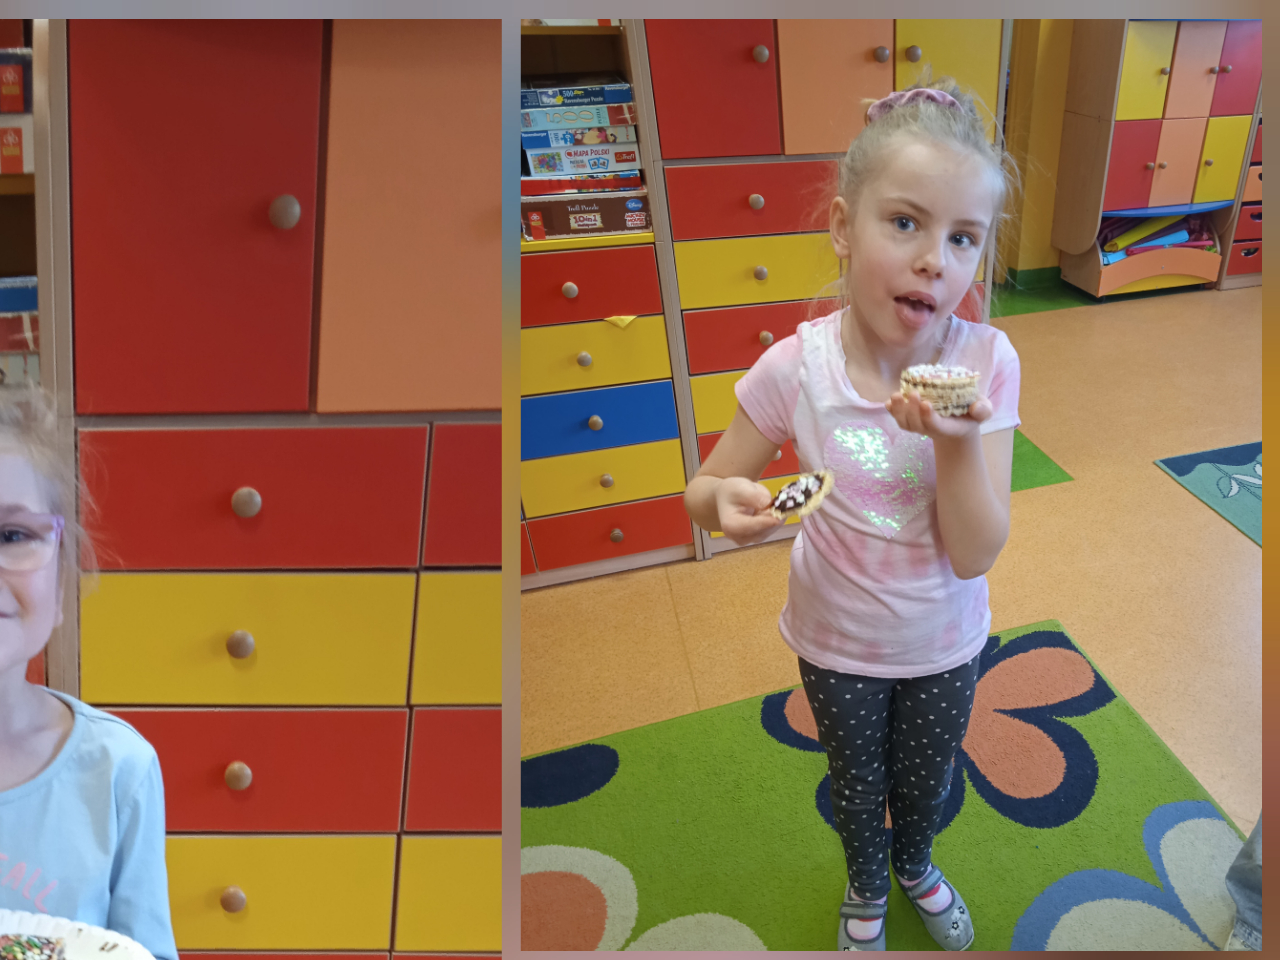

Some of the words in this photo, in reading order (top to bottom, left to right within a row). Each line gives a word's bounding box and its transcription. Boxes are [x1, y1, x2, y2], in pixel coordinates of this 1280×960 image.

[546, 110, 594, 124] 500
[573, 149, 589, 157] MAPA
[590, 148, 610, 156] POLSKI
